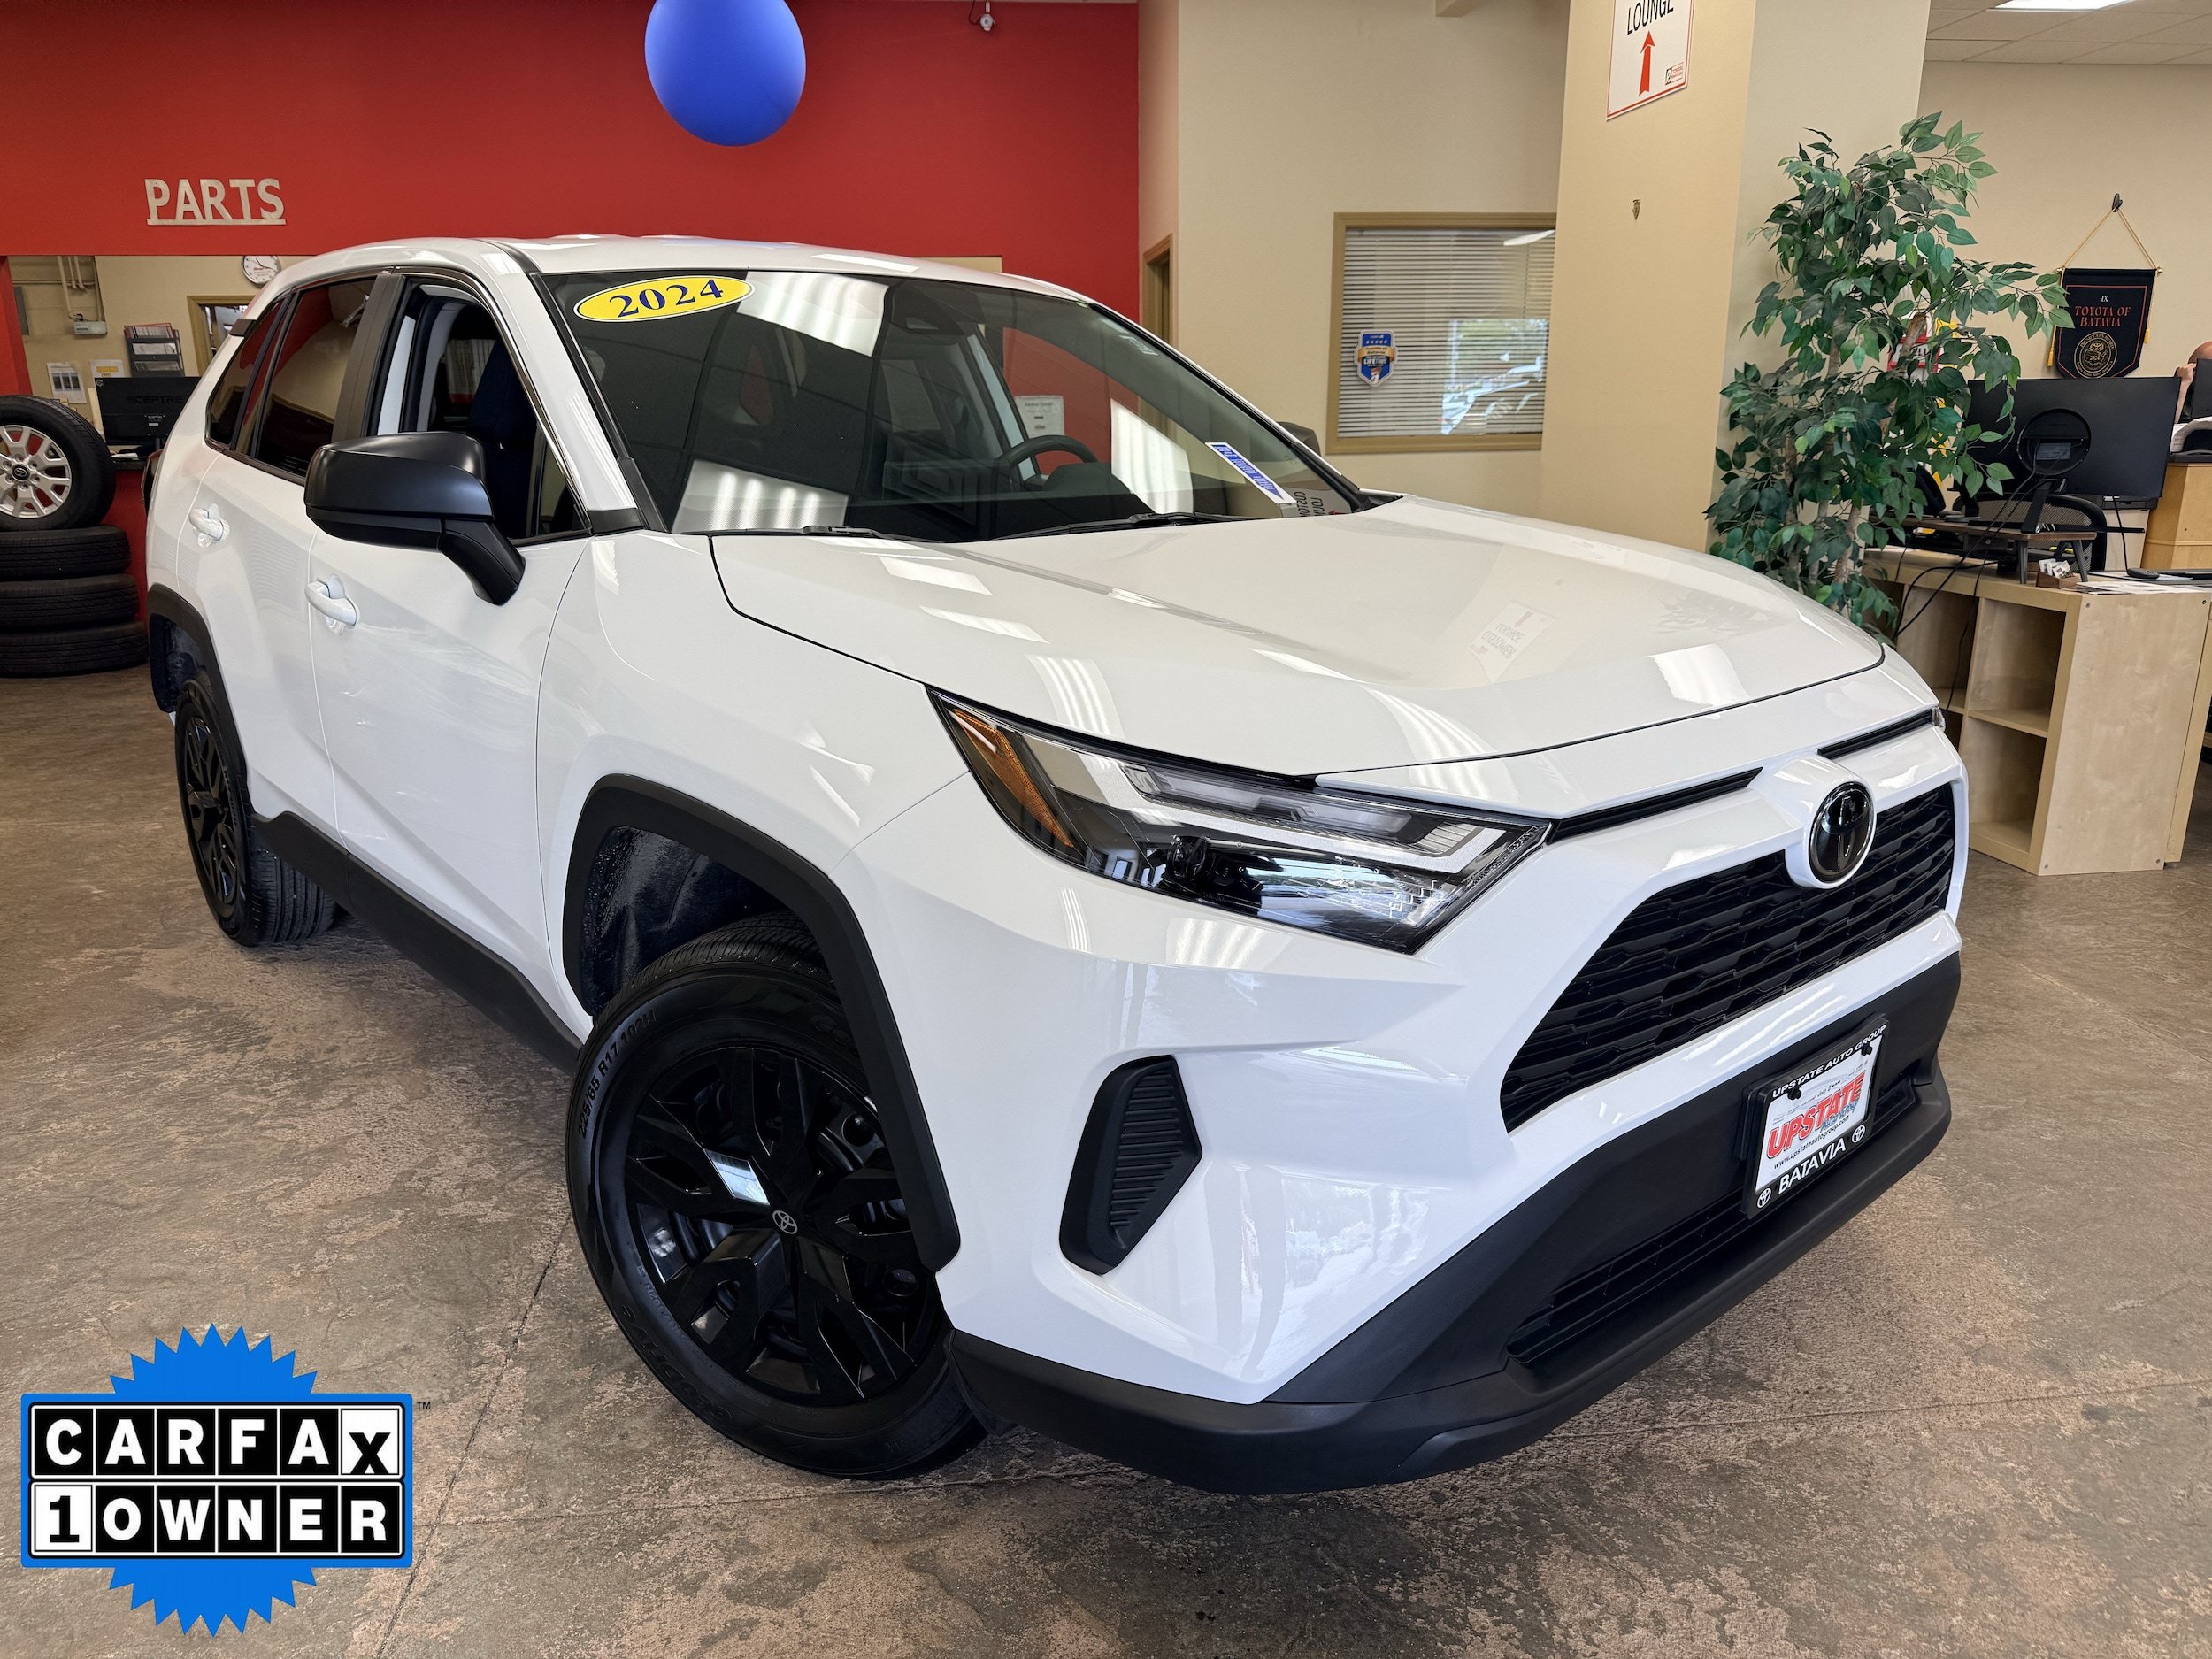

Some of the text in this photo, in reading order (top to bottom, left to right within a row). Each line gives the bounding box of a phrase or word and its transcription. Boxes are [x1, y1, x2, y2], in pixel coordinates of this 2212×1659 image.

[144, 178, 285, 221] PARTS
[609, 279, 724, 318] 2024
[2074, 305, 2131, 317] TOYOTA OF
[2080, 317, 2121, 327] BATAVIA
[127, 396, 184, 404] SCEPTRE
[1772, 1064, 1824, 1098] UPSTATE
[1824, 1048, 1855, 1071] AUTO
[1855, 1025, 1886, 1051] GROUP
[578, 1076, 601, 1140] 225/65
[597, 1041, 619, 1078] R17
[1766, 1071, 1867, 1159] UPSTATE
[1774, 1116, 1849, 1169] www.upstateautogroup.com
[1778, 1137, 1847, 1194] BATAVIA
